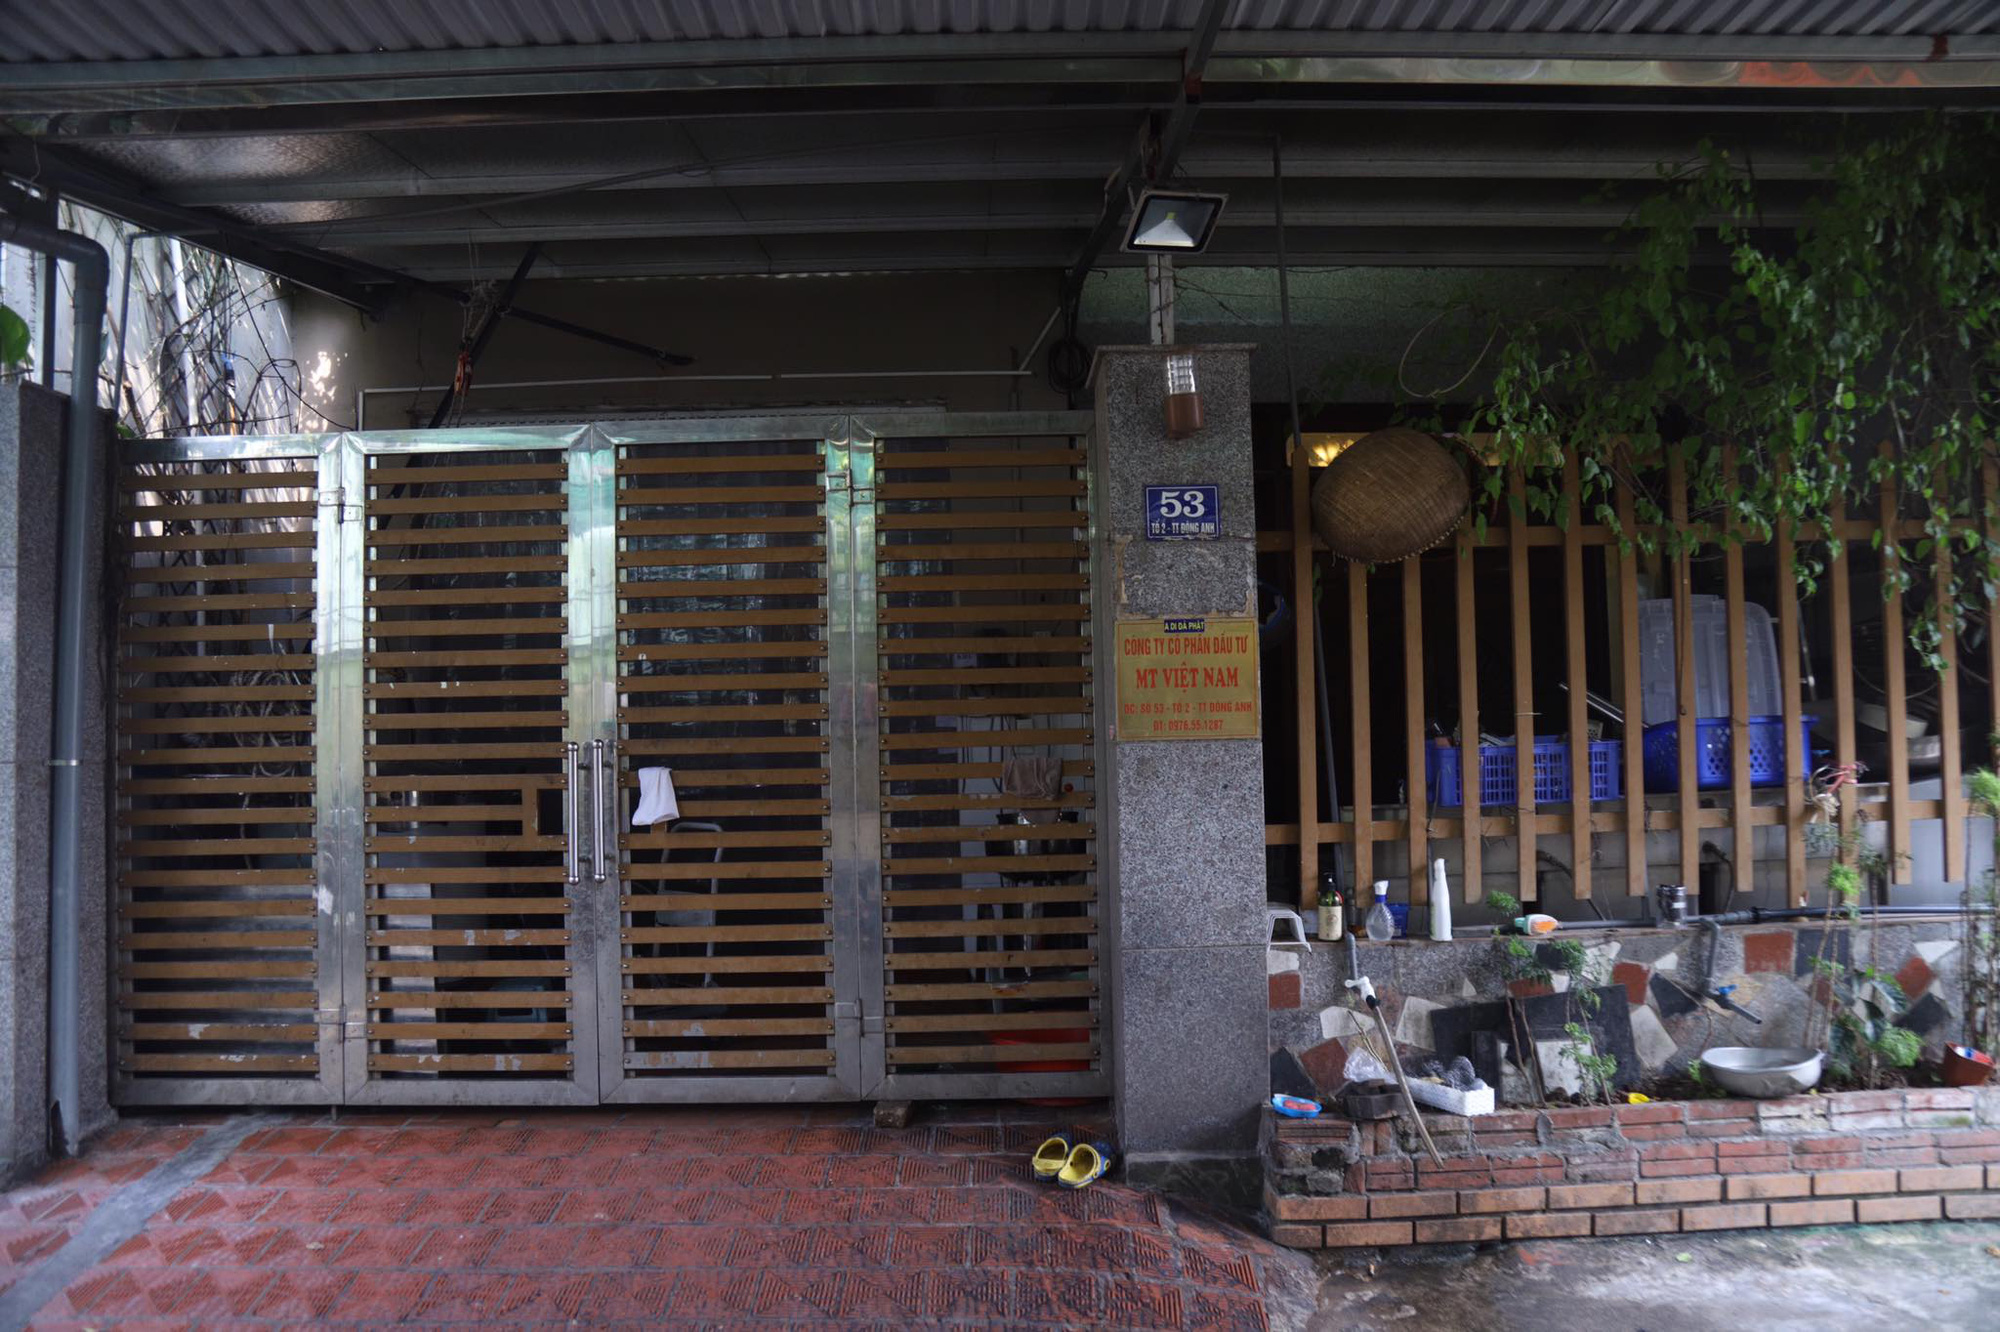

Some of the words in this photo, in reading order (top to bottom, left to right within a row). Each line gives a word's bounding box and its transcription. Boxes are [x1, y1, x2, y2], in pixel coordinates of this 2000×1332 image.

[1160, 490, 1205, 518] 53
[1160, 522, 1166, 534] 2
[1172, 522, 1180, 534] TT
[1180, 520, 1200, 534] ĐÔNG
[1201, 522, 1215, 533] ANH
[1124, 634, 1151, 656] CÔNG
[1154, 638, 1165, 656] TY
[1235, 635, 1248, 654] TƯ
[1136, 668, 1158, 688] MT
[1162, 661, 1199, 693] VIỆT
[1204, 666, 1239, 688] NAM
[1154, 702, 1164, 714] 53
[1186, 702, 1190, 713] 2
[1198, 702, 1206, 712] TT
[1234, 702, 1252, 712] ANH
